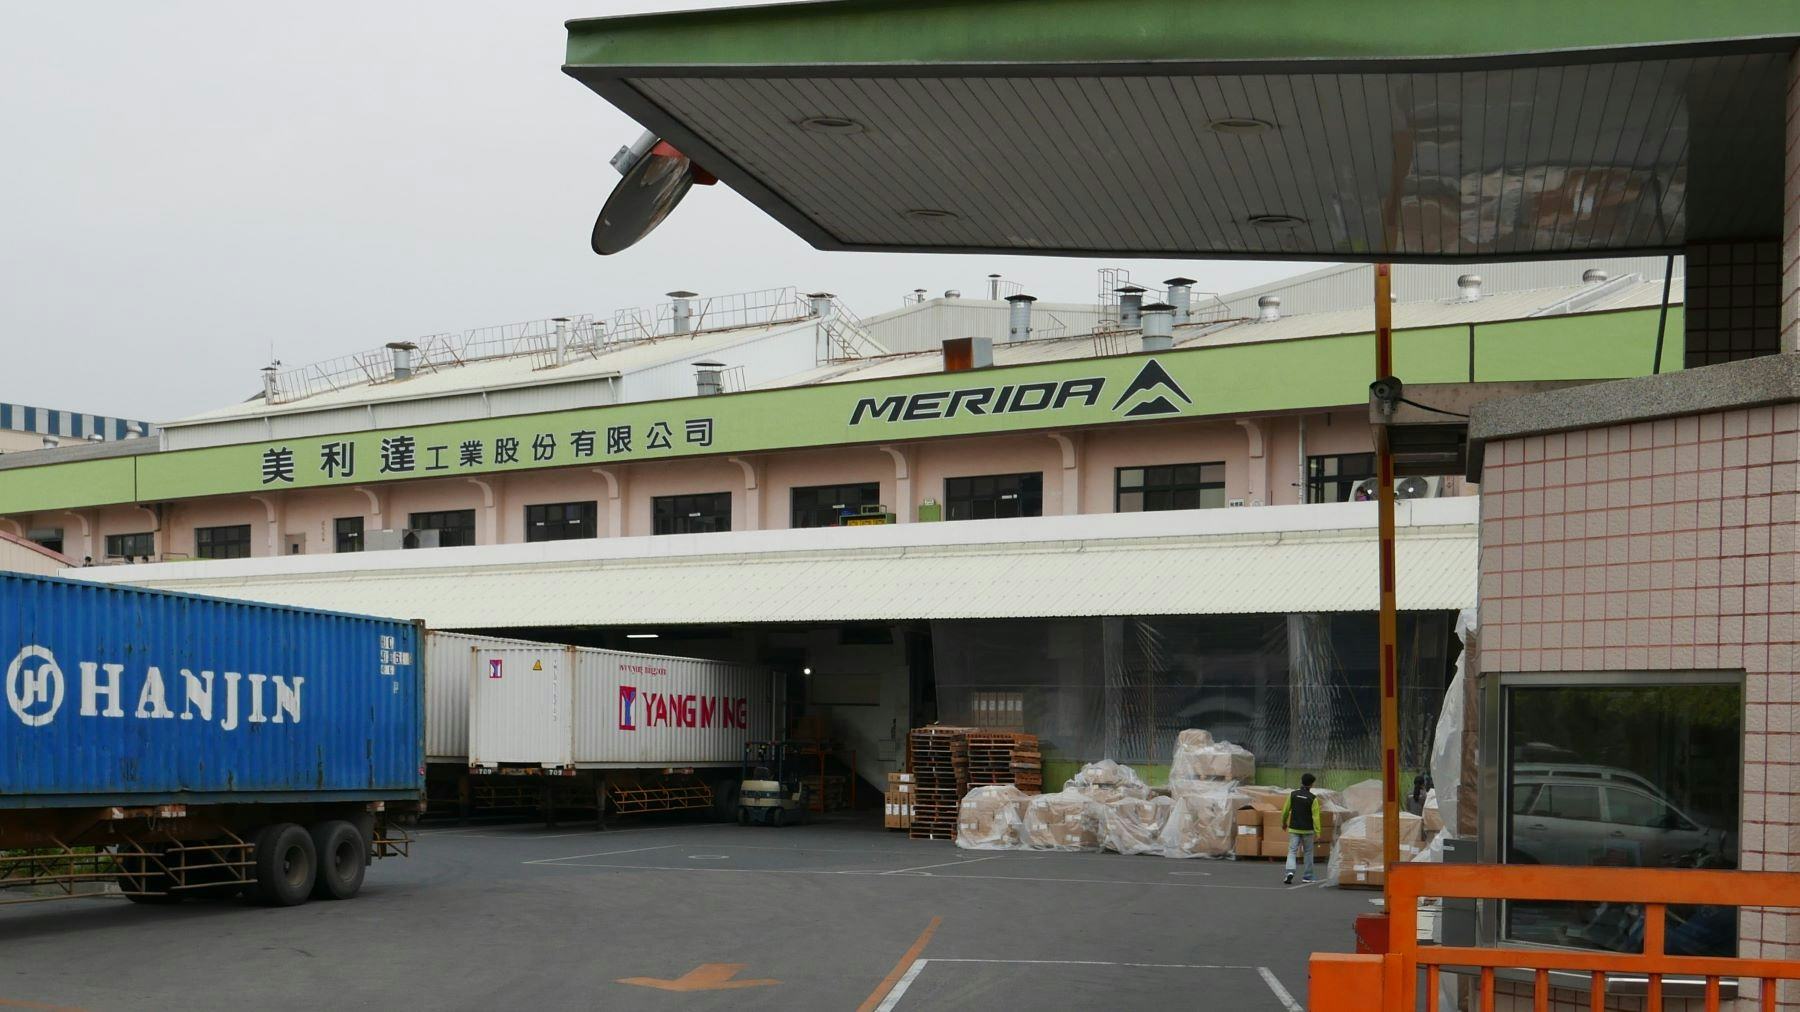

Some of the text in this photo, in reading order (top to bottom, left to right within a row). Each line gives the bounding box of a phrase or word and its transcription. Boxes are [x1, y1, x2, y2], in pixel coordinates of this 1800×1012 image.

[849, 376, 1107, 426] MERIDA
[261, 417, 715, 485] 美利達工業股份有限公司
[79, 661, 305, 731] HANJIN
[642, 692, 747, 729] YANG MING
